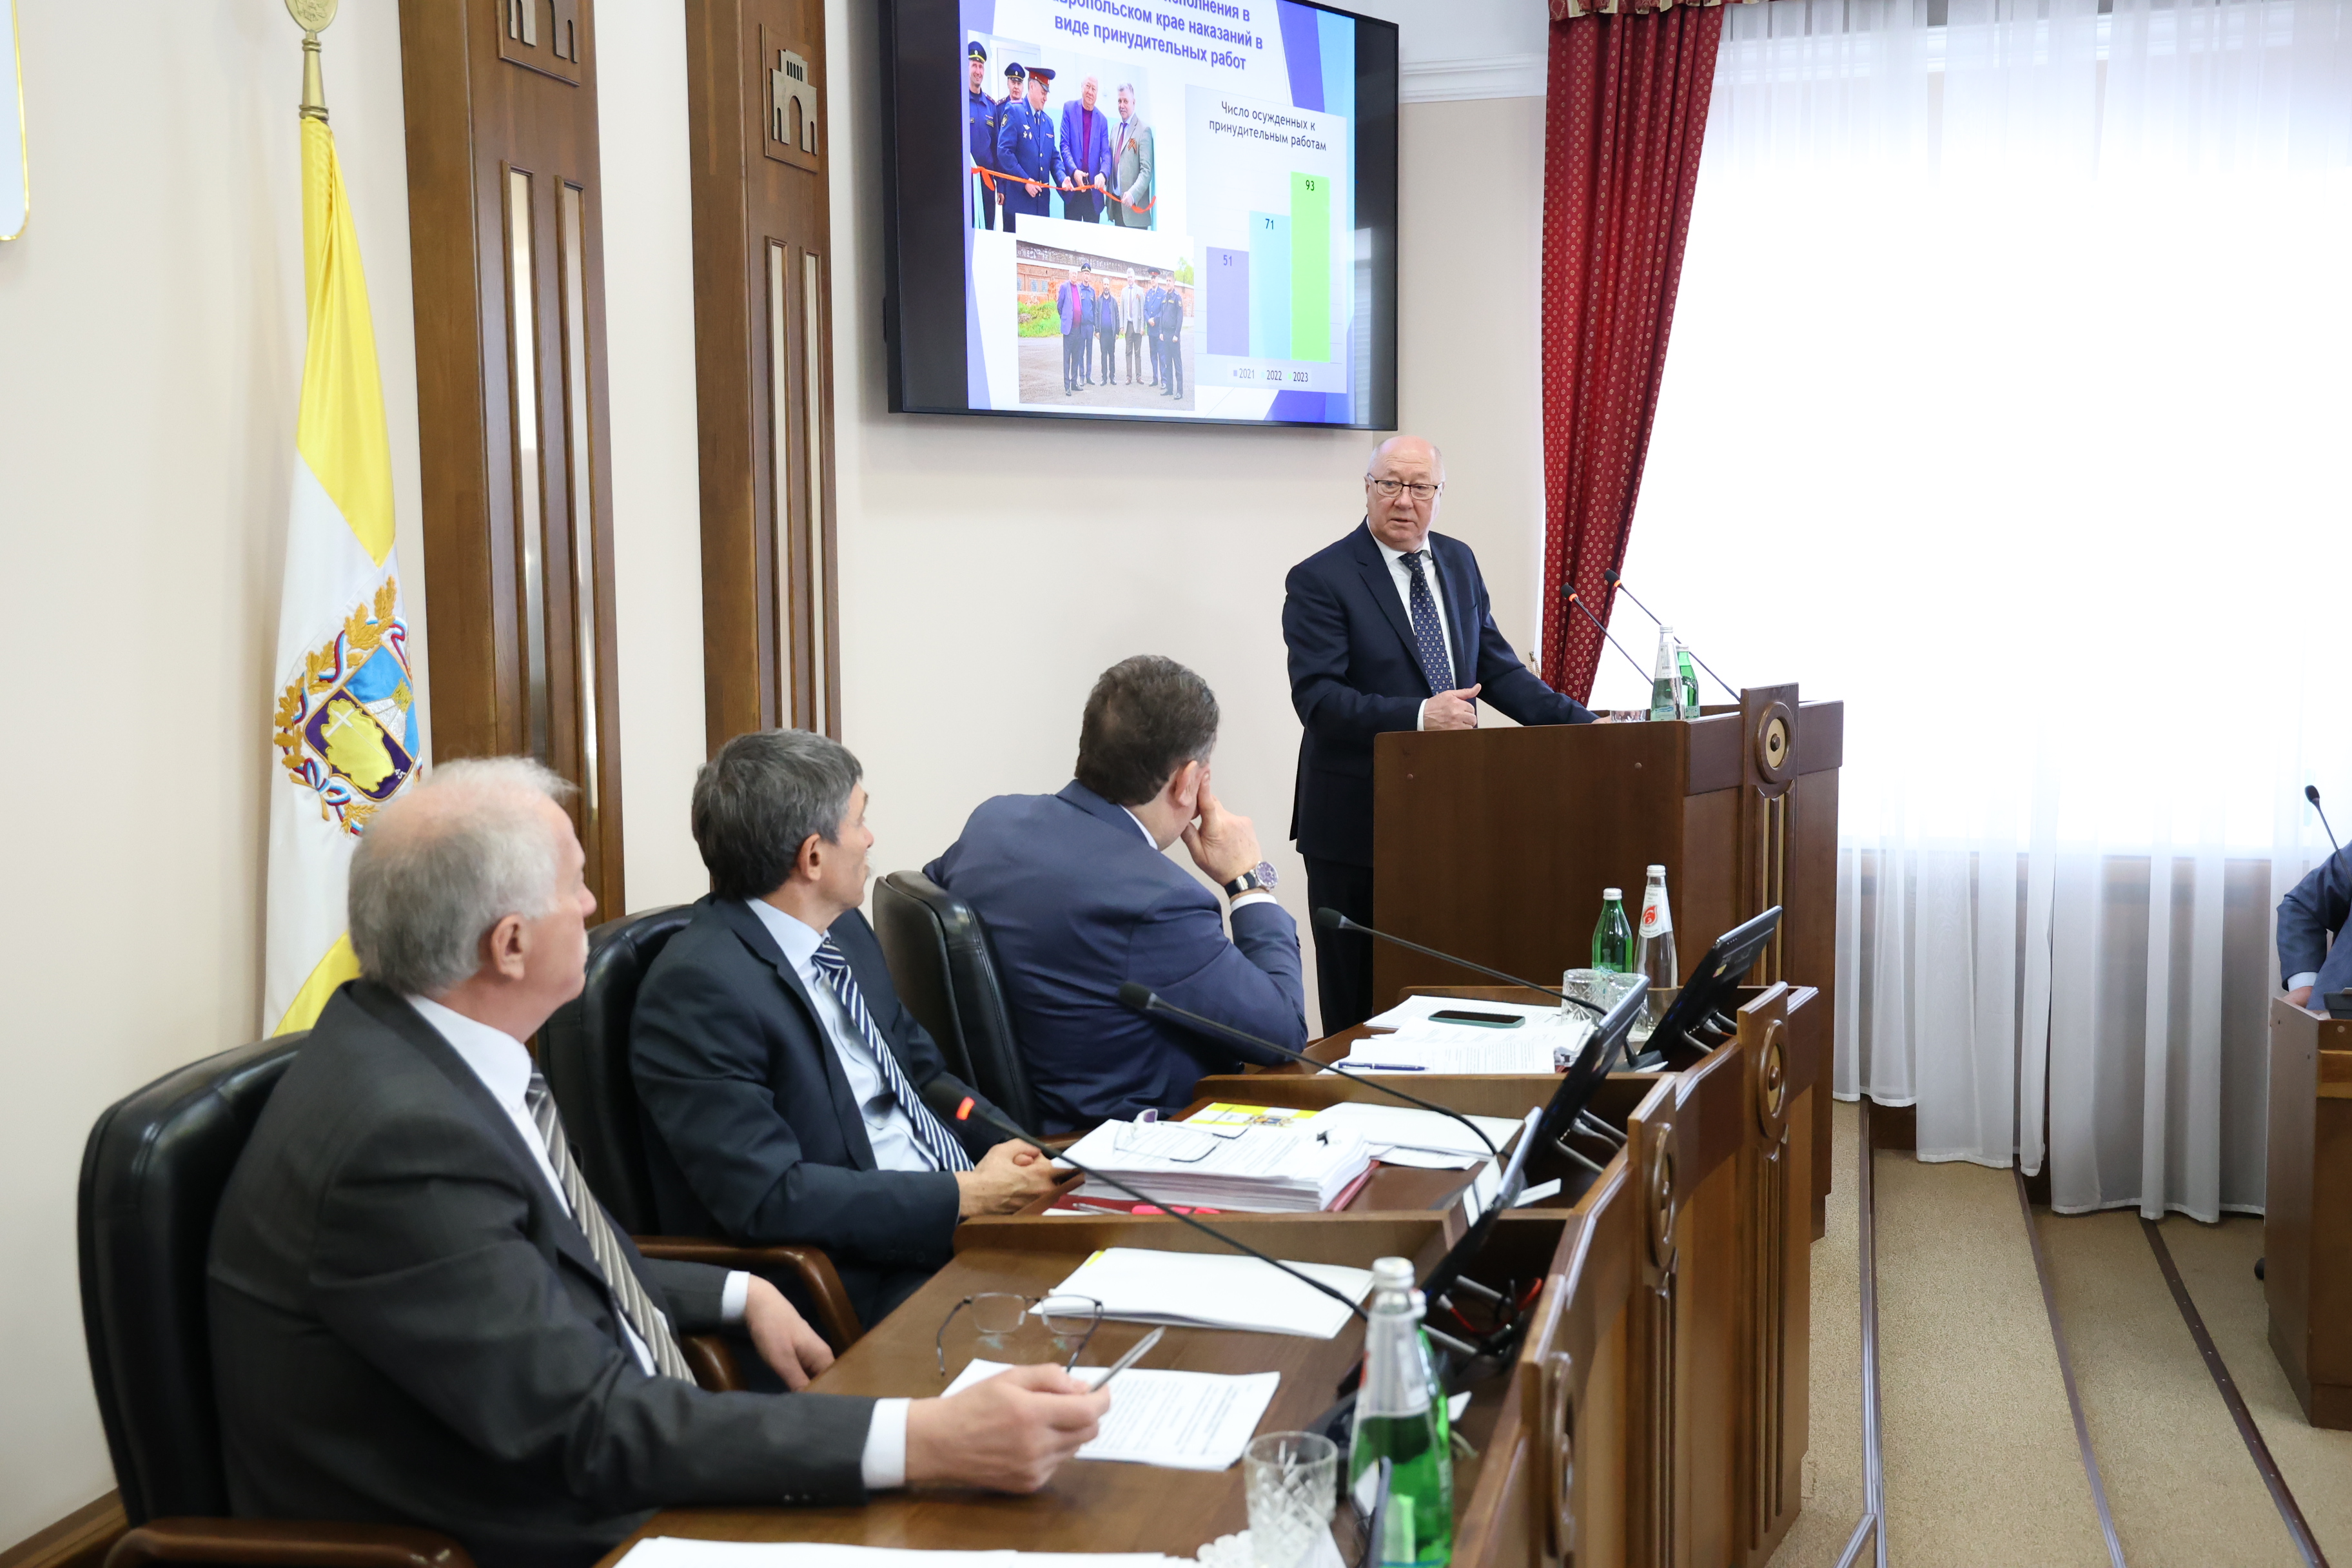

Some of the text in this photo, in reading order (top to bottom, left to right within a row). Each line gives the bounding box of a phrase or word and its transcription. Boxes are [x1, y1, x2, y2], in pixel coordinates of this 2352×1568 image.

[1164, 0, 1250, 22] олнения в
[1053, 0, 1263, 50] ропольском крае наказаний в
[1055, 15, 1246, 70] виде принудительных работ
[1221, 101, 1315, 131] Число осужденных к
[1209, 120, 1326, 151] принудительным работам
[1306, 179, 1315, 191] 93
[1265, 218, 1274, 230] 71
[1223, 254, 1232, 266] 51
[1239, 368, 1309, 382] 2021 2022 2023
